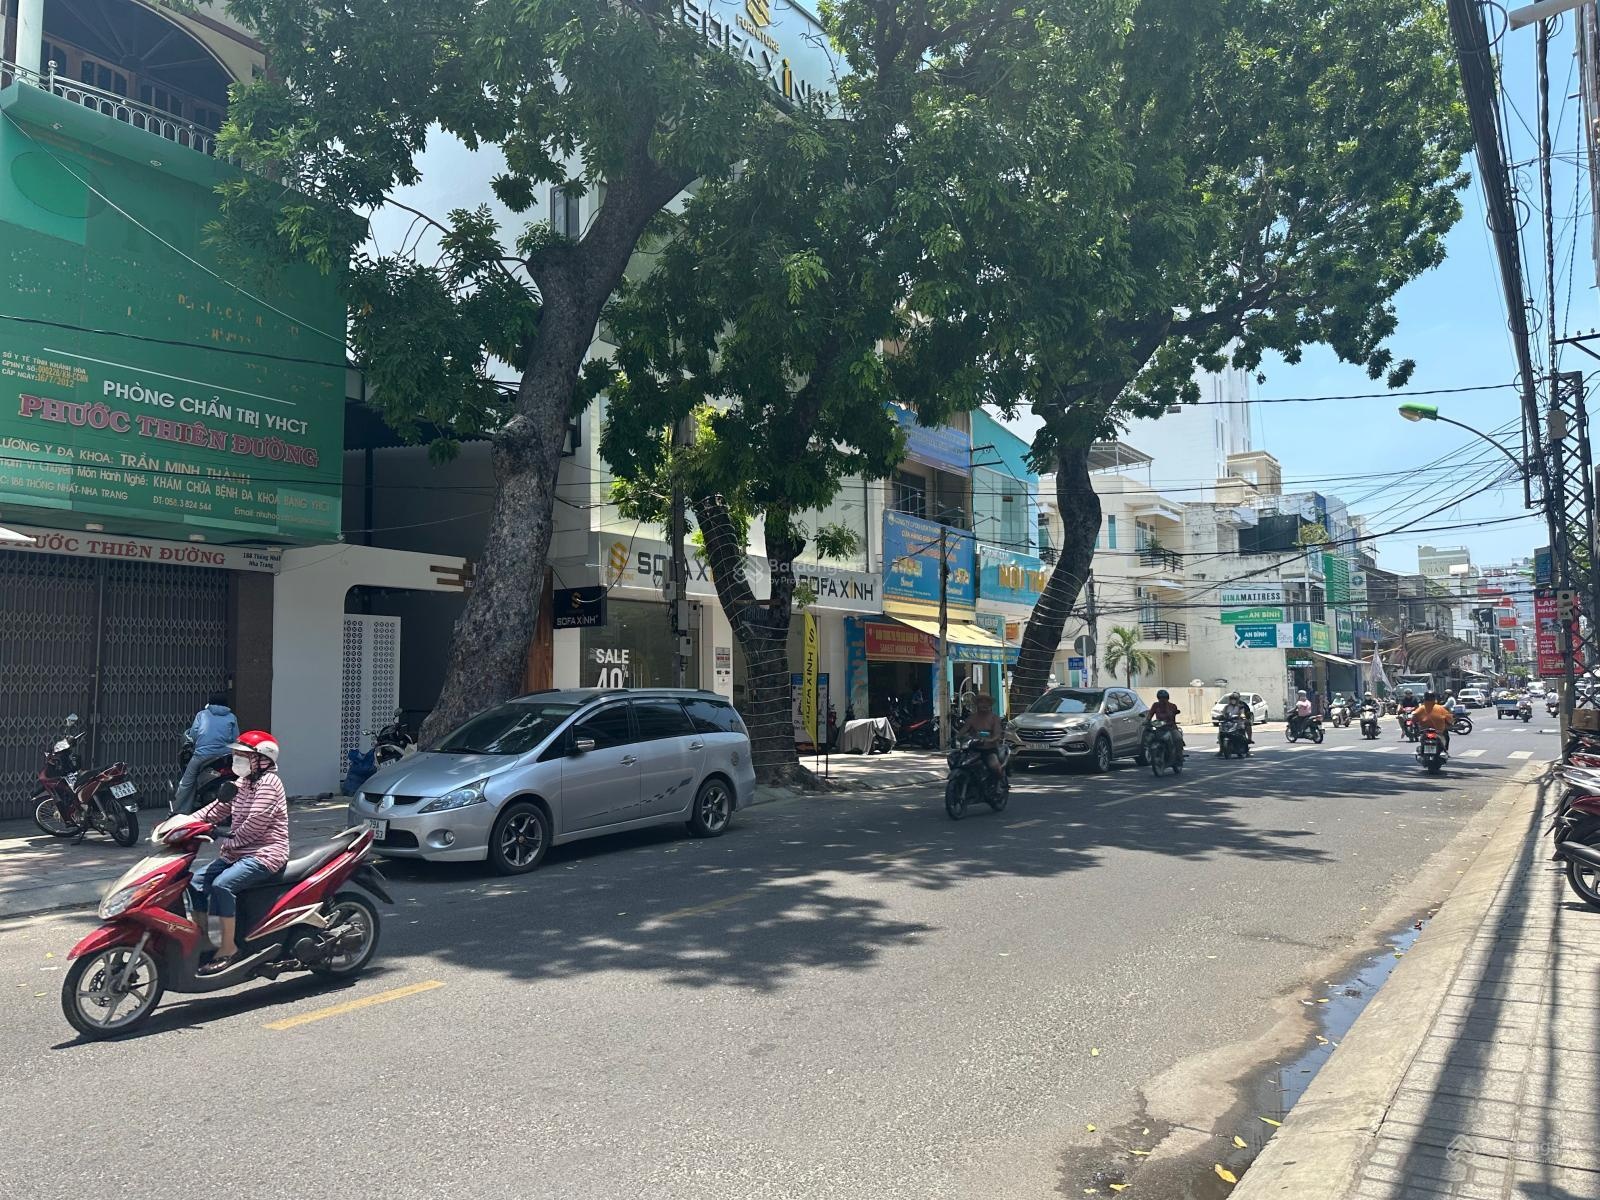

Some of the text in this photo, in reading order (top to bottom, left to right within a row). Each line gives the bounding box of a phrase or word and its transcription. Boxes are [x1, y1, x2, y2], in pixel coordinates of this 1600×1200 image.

[735, 14, 780, 54] FURNITURE
[103, 380, 308, 435] PHÒNG CHẨN TRỊ YHCT
[136, 414, 228, 451] THIÊN
[231, 433, 320, 468] ĐƯỜNG
[44, 444, 53, 454] Y
[57, 446, 75, 458] ĐA
[120, 451, 160, 471] TRẦN
[165, 461, 200, 477] MINH
[101, 488, 128, 500] TRANG
[153, 476, 182, 492] KHÁM
[215, 484, 238, 500] BỆNH
[241, 489, 254, 501] ĐA
[257, 491, 279, 505] KHOA
[87, 540, 153, 559] THIÊN
[159, 547, 226, 566] ĐƯỜNG
[596, 649, 629, 664] SALE
